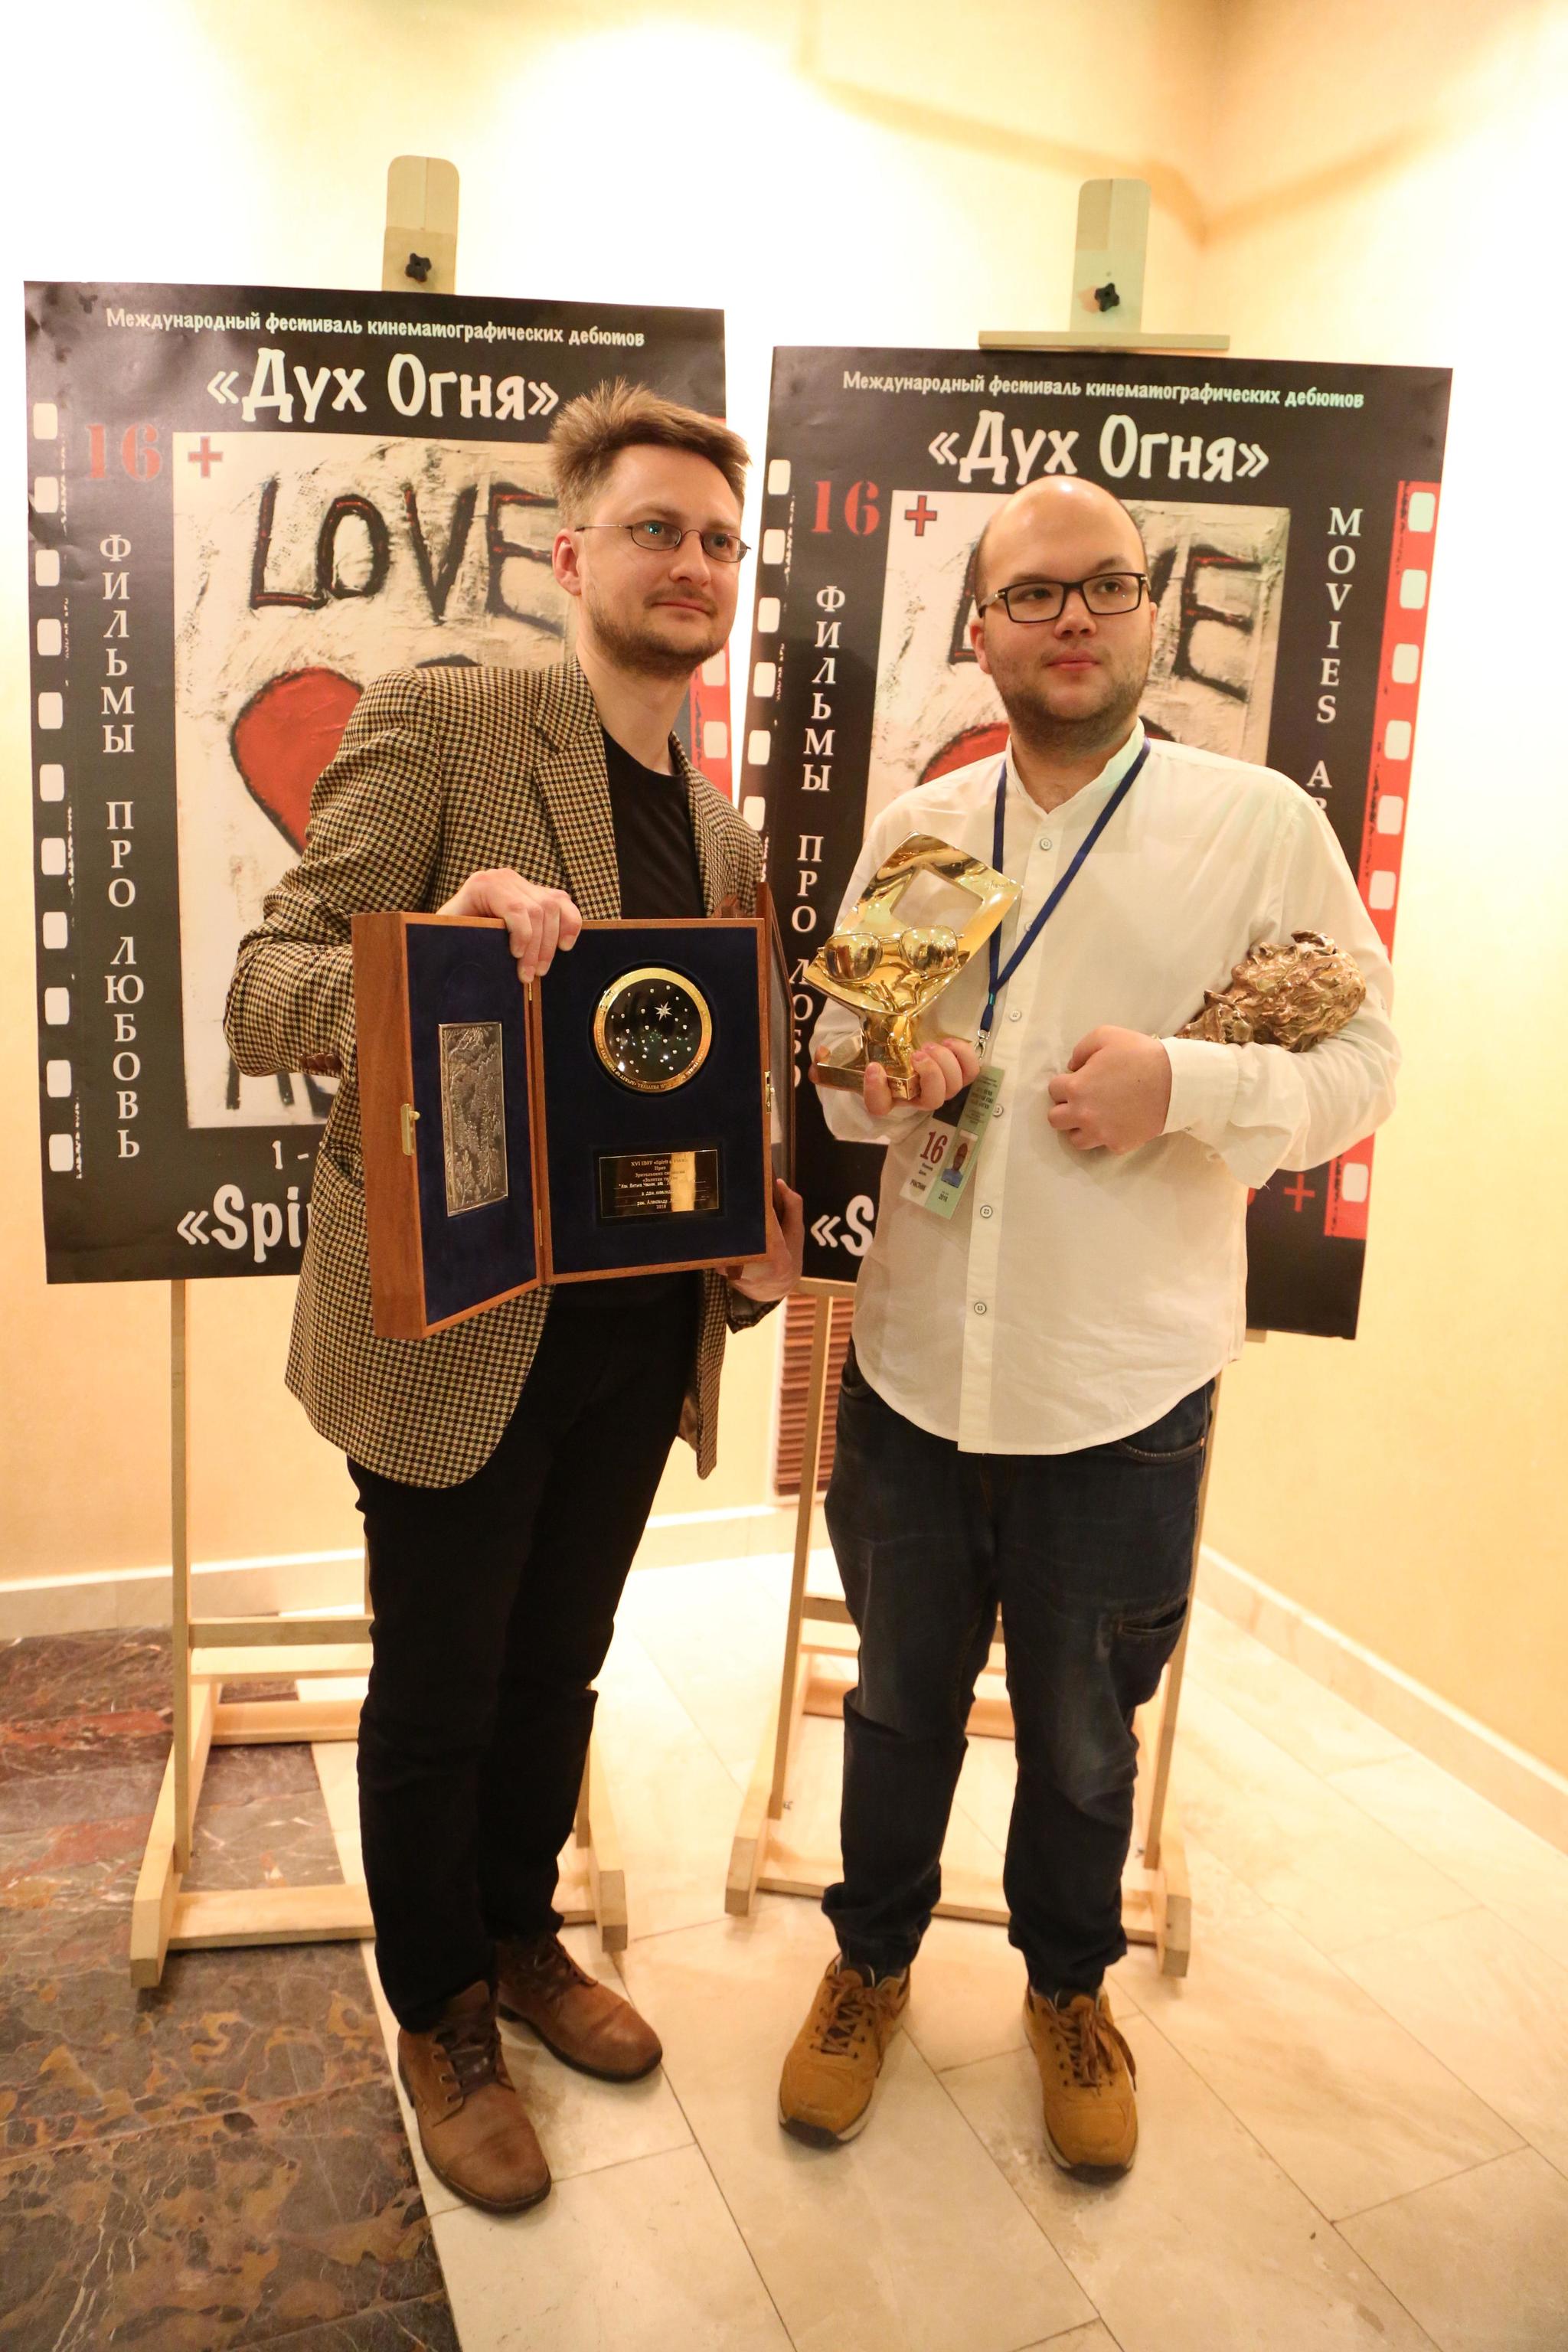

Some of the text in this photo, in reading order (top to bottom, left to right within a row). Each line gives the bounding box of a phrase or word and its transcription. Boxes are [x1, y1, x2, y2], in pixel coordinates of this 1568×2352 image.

[106, 308, 645, 347] Международный фестиваль кинематографических дебютов
[207, 347, 560, 423] «Дух Огня»
[842, 371, 1364, 409] Международный фестиваль кинематографических дебютов
[85, 423, 162, 481] 16
[928, 409, 1269, 485] «Дух Огня»
[812, 480, 880, 536] 16
[248, 477, 565, 639] LOVE
[1315, 507, 1364, 724] MOVIES
[801, 585, 846, 792] ФИЛЬМЫ
[100, 534, 145, 1159] ФИЛЬМЫ ПРО ЛЮБОВЬ
[791, 834, 825, 933] ПРО
[920, 1131, 949, 1164] 16
